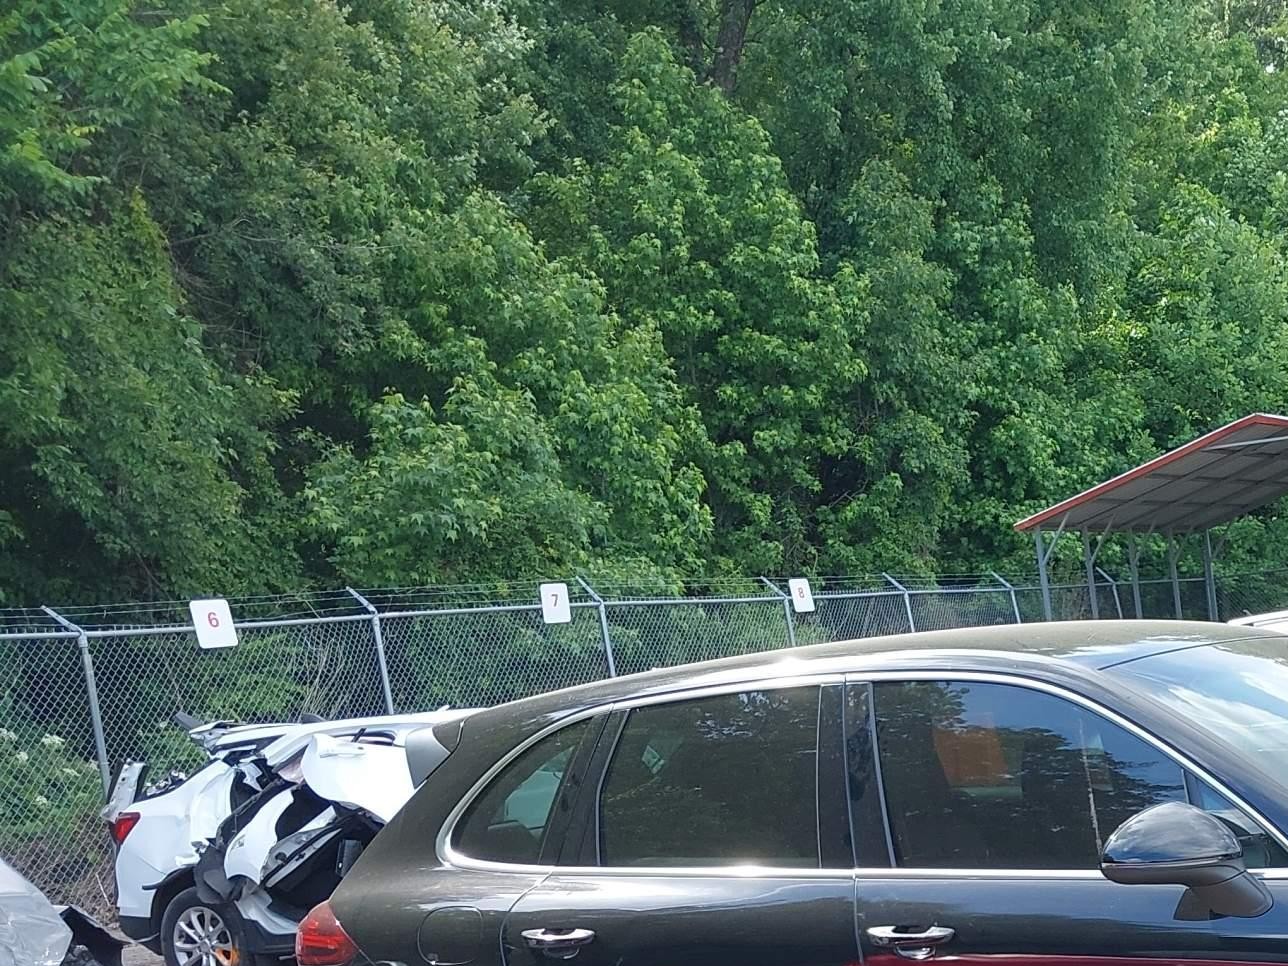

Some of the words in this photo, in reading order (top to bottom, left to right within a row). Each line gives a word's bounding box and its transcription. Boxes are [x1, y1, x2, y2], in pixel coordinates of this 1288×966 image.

[551, 593, 559, 607] 7
[797, 587, 805, 599] 8
[207, 611, 220, 628] 6
